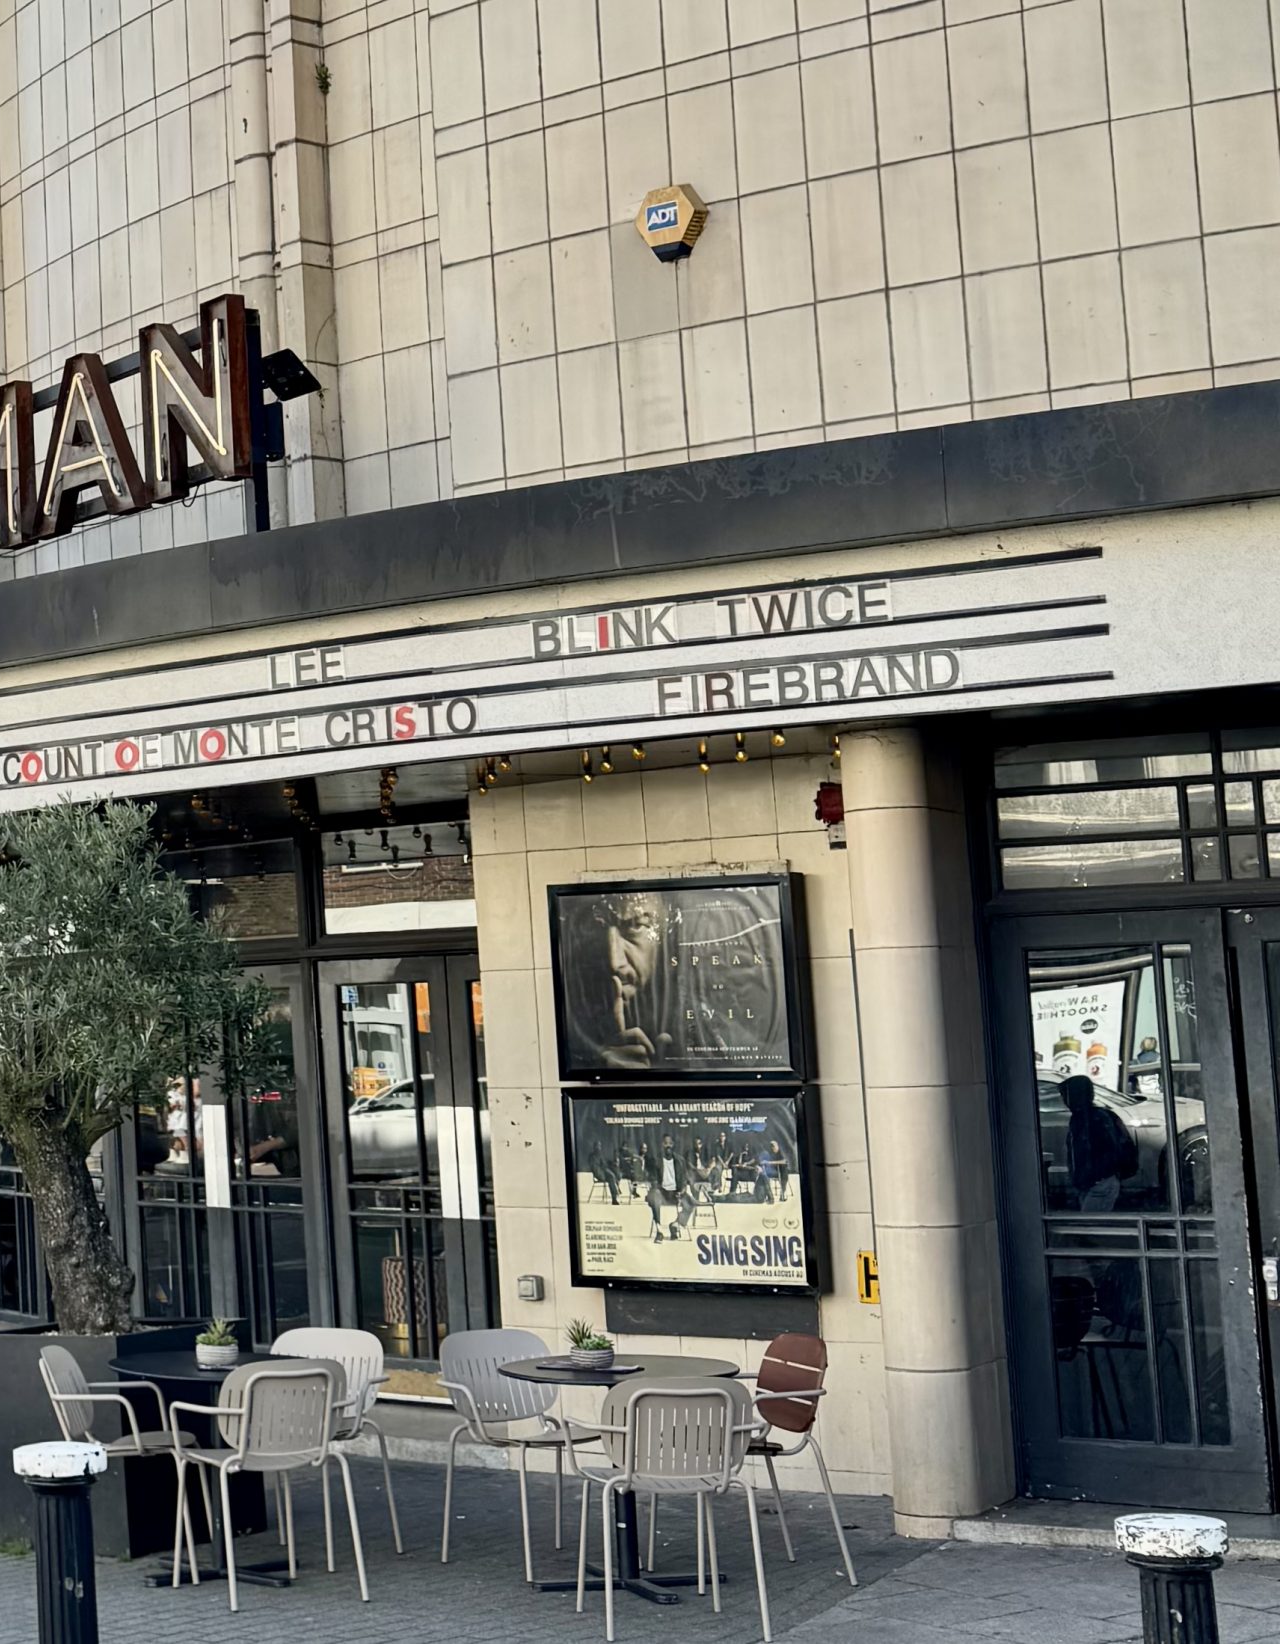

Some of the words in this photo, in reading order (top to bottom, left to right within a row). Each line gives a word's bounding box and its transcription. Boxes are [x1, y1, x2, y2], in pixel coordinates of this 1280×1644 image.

[648, 206, 677, 226] ADT
[532, 603, 679, 659] BLINK
[717, 583, 889, 637] TWICE
[271, 645, 345, 690] LEE
[656, 649, 961, 716] FIREBRAND
[2, 741, 103, 785] COUNT
[115, 735, 159, 771] OF
[174, 718, 298, 767] MONTE
[325, 697, 477, 746] CRISTO
[670, 954, 763, 967] SPEAK
[686, 1008, 755, 1020] EVIL
[697, 1234, 749, 1266] SING
[750, 1235, 803, 1267] SING
